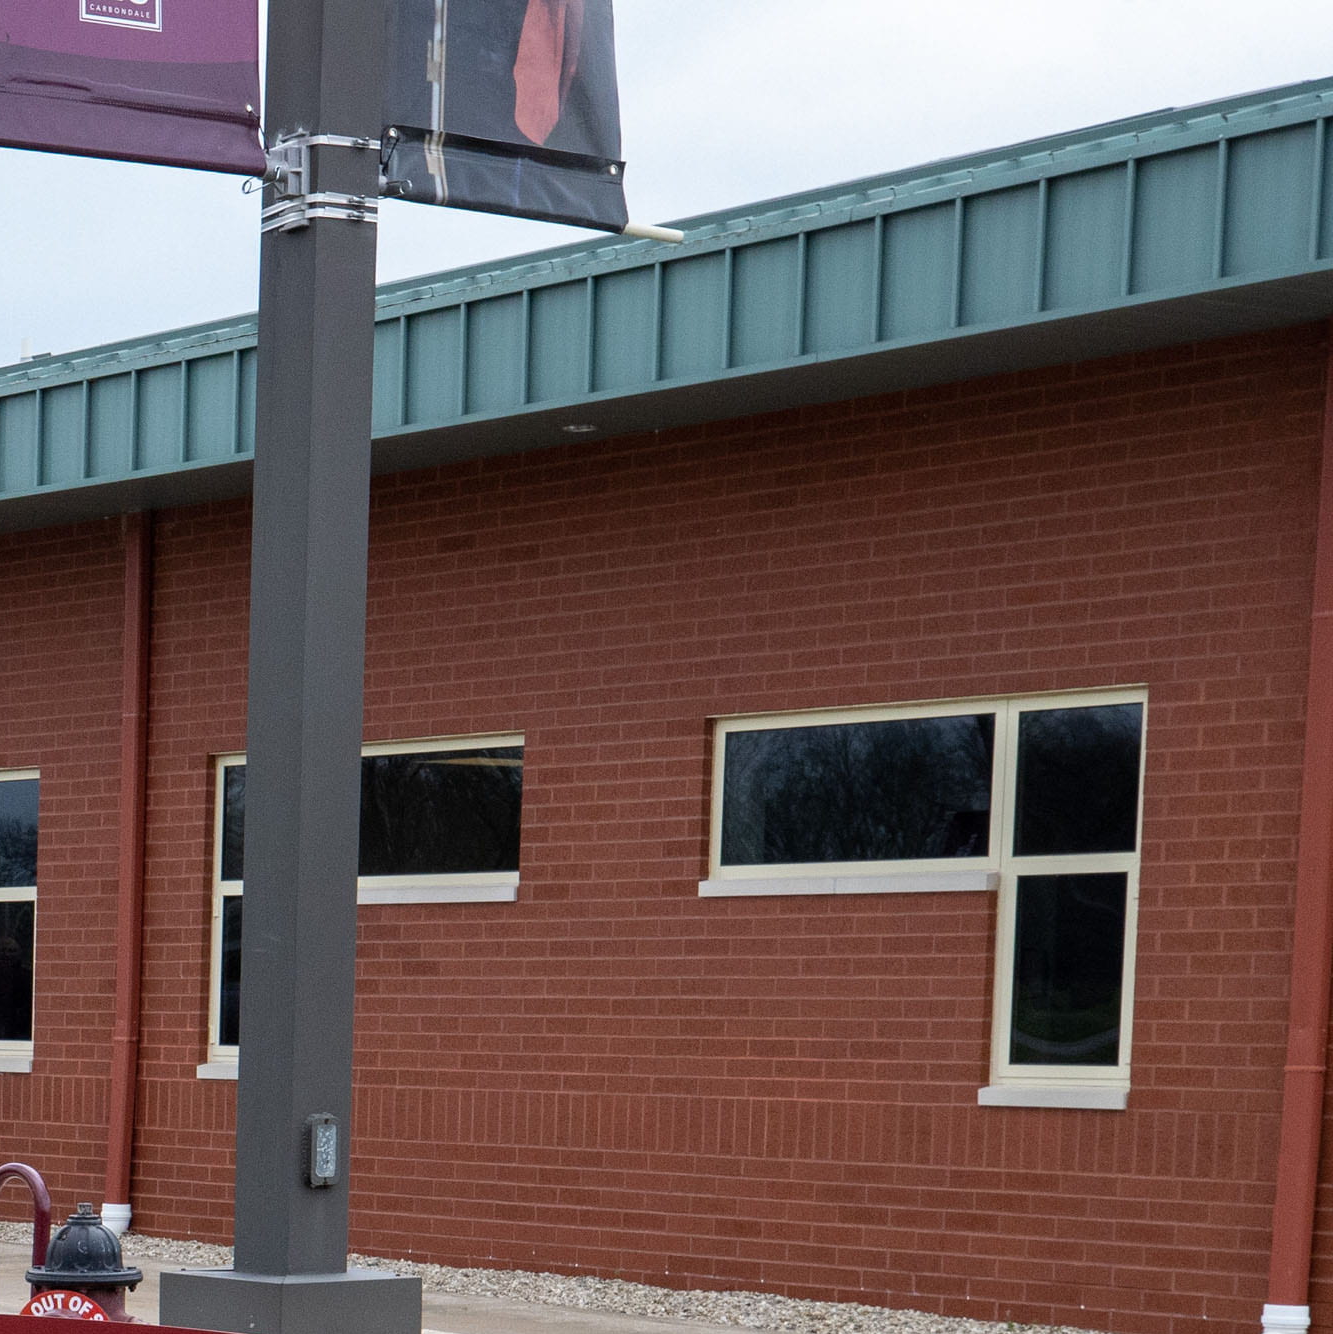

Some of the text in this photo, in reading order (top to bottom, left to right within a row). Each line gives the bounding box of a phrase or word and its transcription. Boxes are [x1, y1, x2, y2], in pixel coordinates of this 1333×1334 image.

[89, 3, 150, 19] CARBONDALE
[30, 1293, 94, 1317] OUT OF
